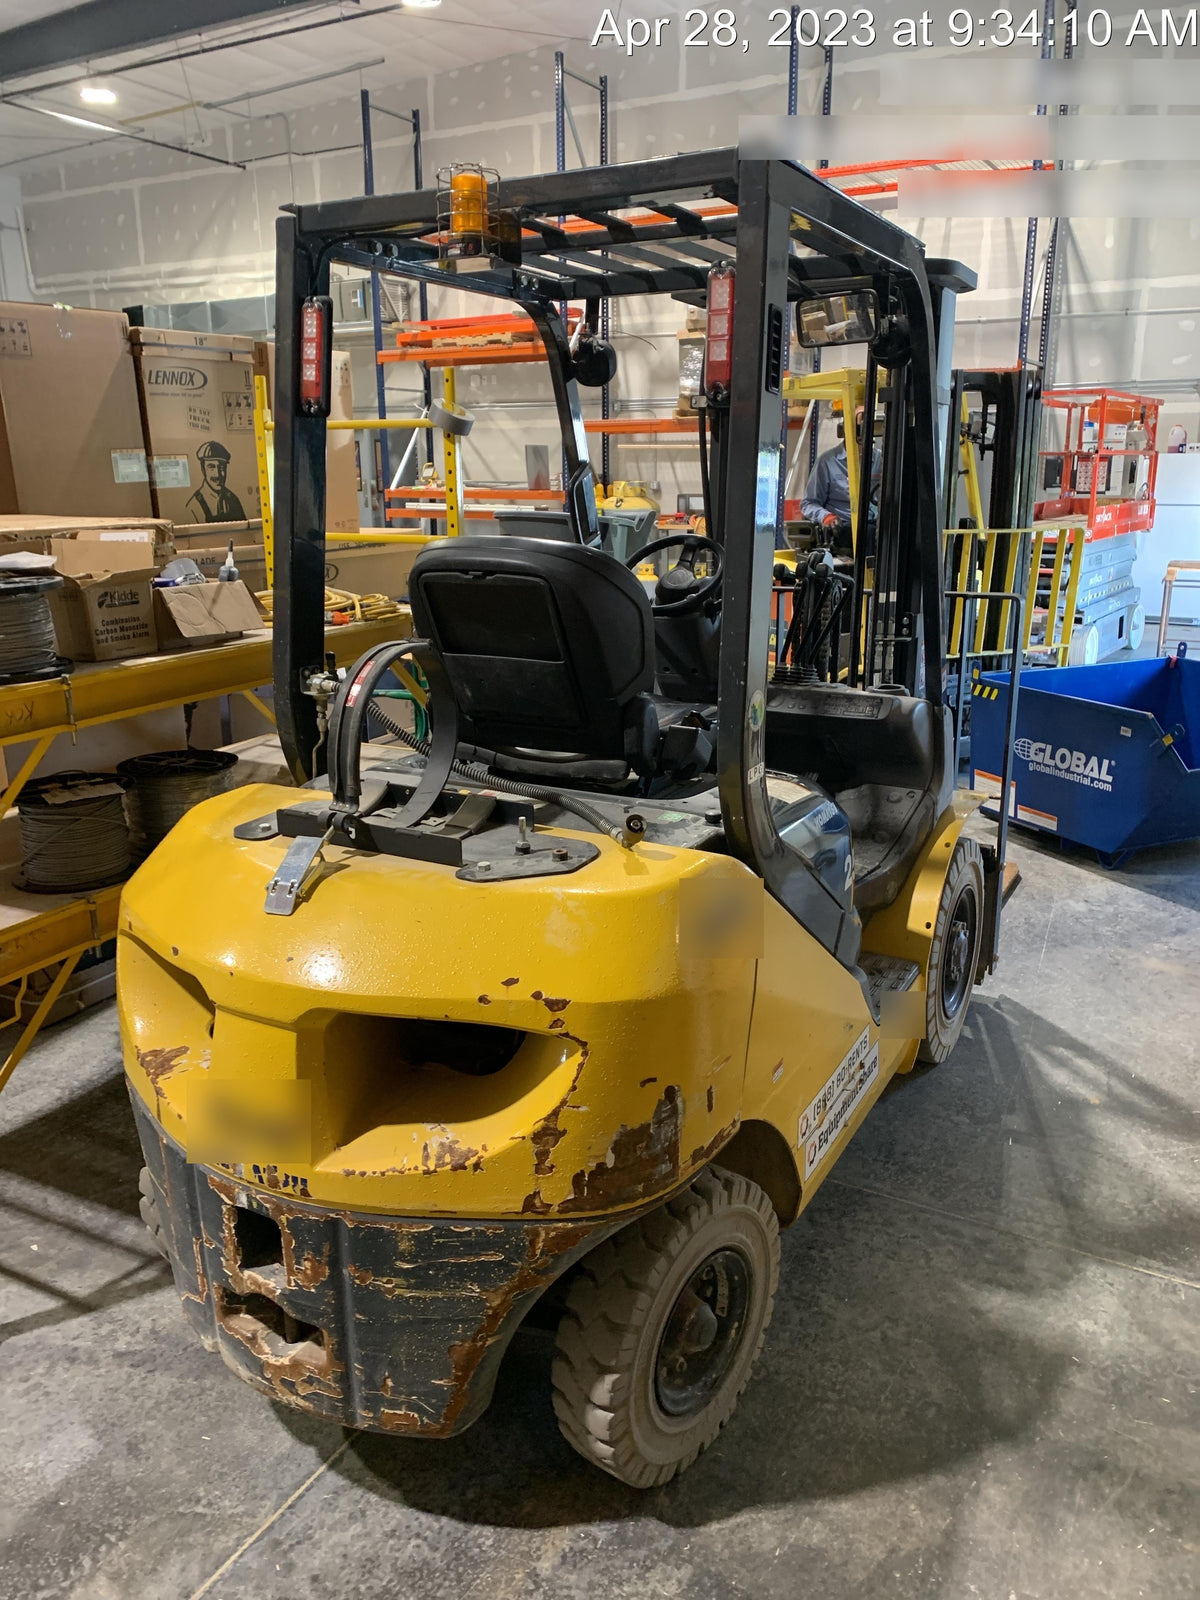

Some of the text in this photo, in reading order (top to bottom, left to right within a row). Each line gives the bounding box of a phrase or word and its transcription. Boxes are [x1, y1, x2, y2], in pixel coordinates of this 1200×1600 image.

[148, 370, 195, 386] LENNOX
[109, 589, 139, 602] Kidde
[95, 622, 148, 636] Carbon Monoxide
[101, 616, 140, 627] Combination
[110, 633, 131, 643] Smoke
[132, 630, 150, 639] Alarm
[1030, 741, 1113, 782] GLOBAL
[748, 764, 764, 780] LPG
[1029, 761, 1112, 792] globalindustrial.com
